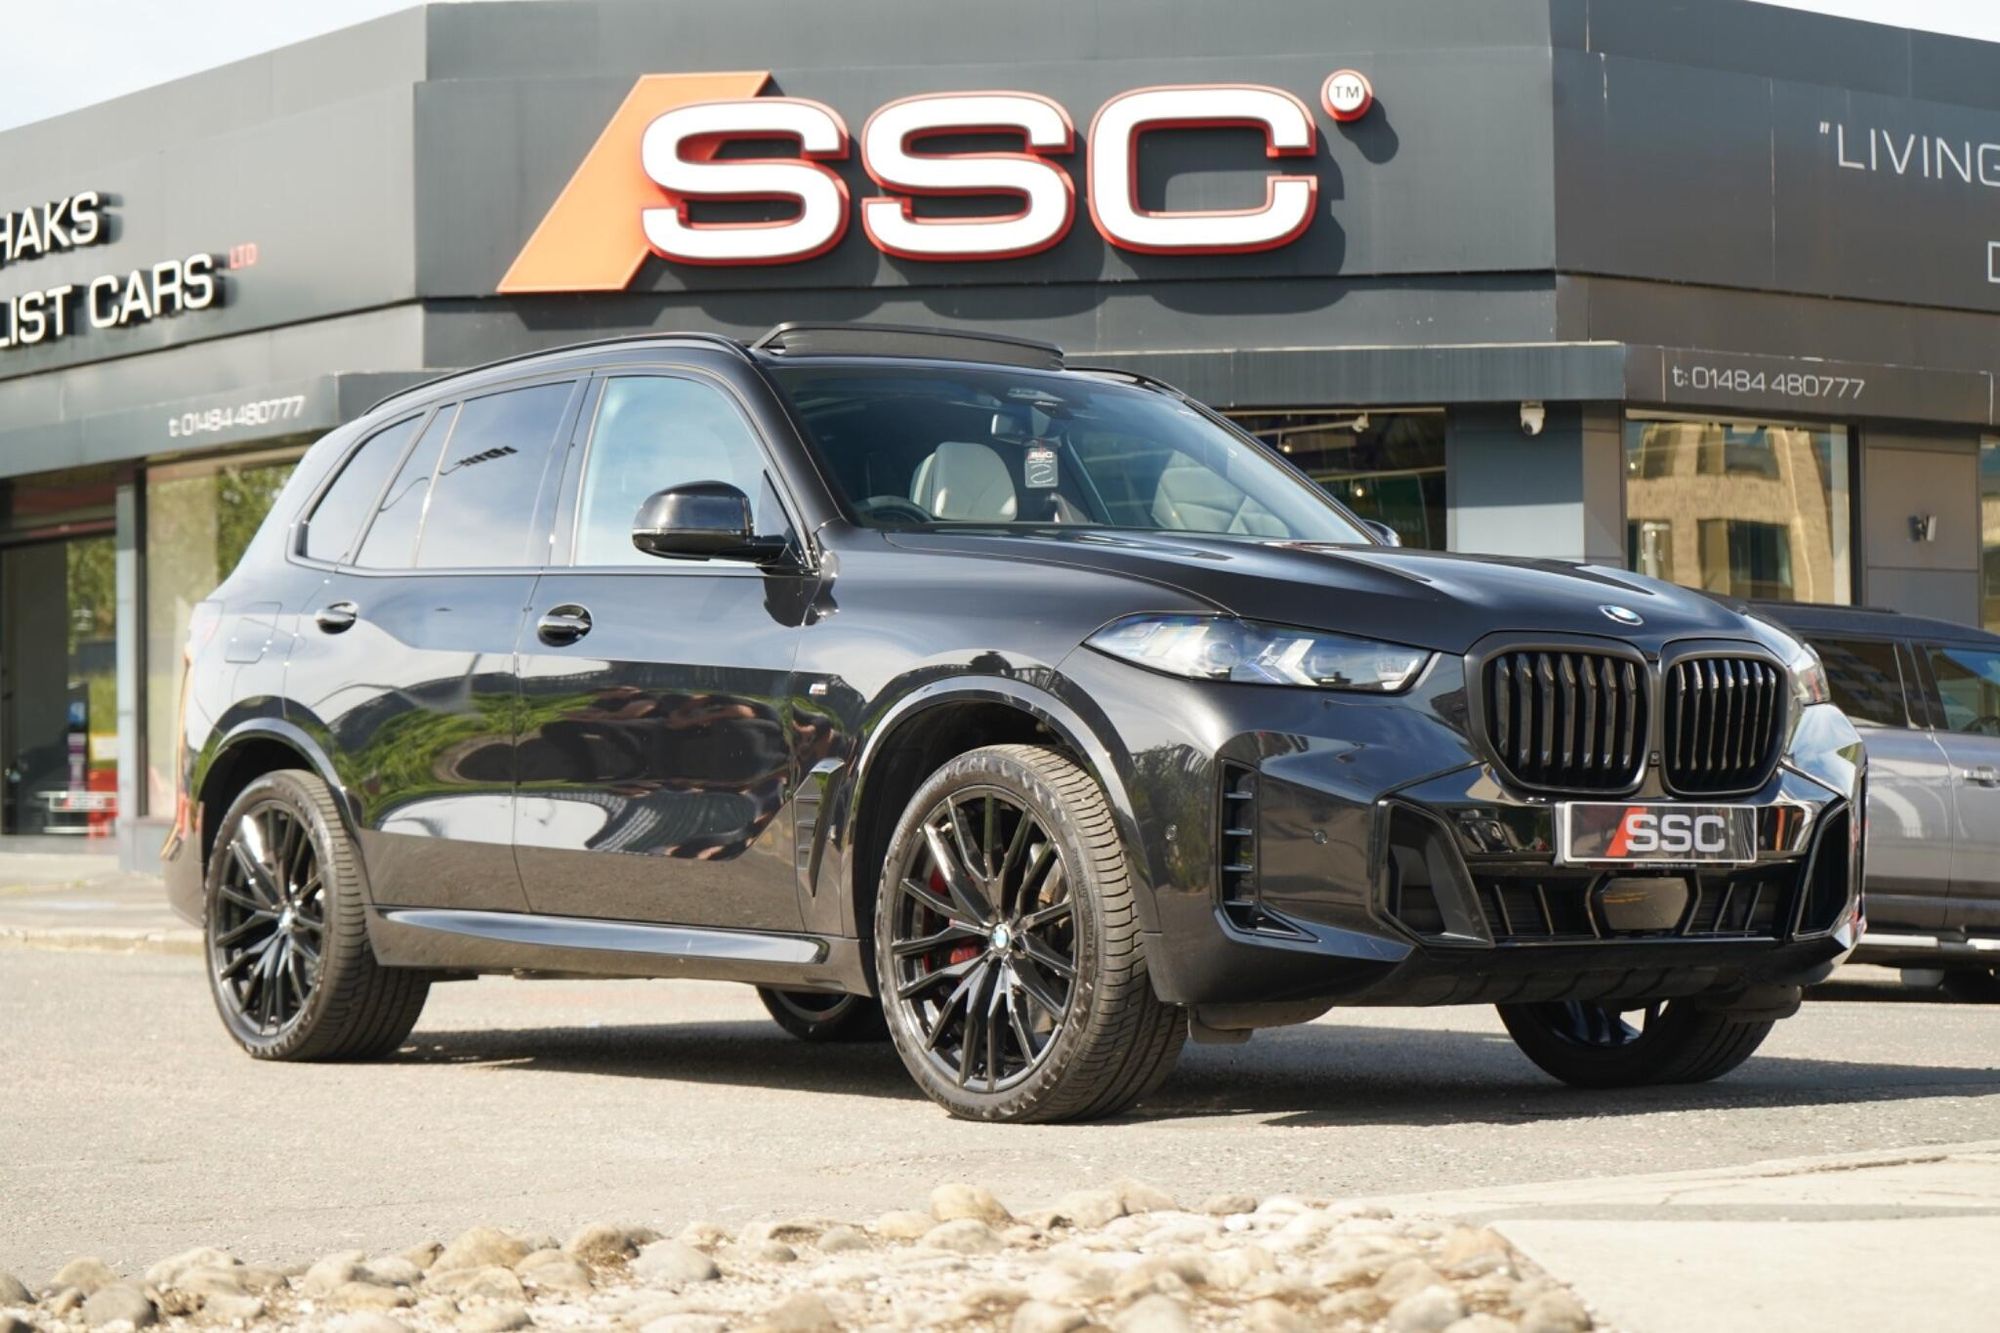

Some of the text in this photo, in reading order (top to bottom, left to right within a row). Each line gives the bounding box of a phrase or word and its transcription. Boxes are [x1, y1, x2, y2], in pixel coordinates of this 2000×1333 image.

[1335, 86, 1360, 99] TM
[641, 84, 1317, 266] SSC
[89, 253, 214, 329] CARS
[229, 243, 258, 270] LTD
[1770, 373, 1866, 400] 480777
[1625, 814, 1725, 852] SSC
